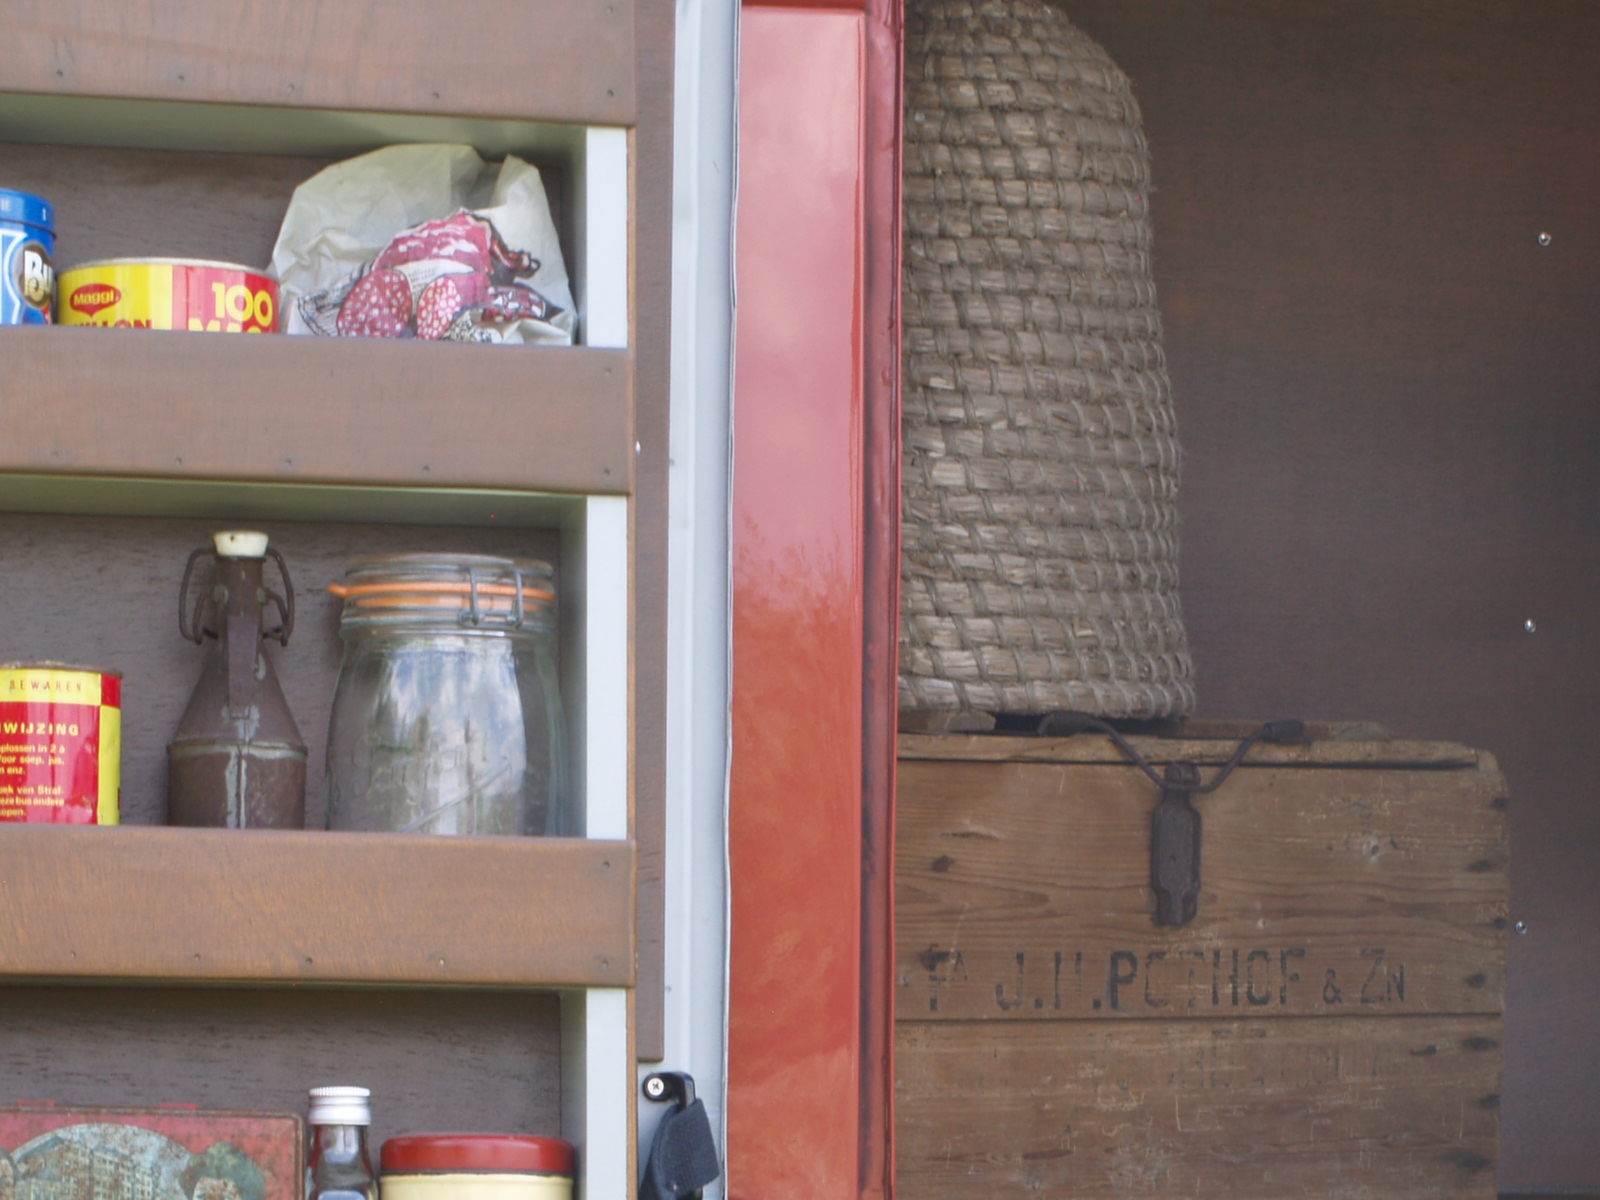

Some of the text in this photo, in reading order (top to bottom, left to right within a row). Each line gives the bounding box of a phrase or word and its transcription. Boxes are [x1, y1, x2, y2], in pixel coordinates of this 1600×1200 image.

[74, 288, 115, 305] Maggi
[212, 282, 273, 327] 100
[0, 721, 79, 736] WIJZING
[1323, 968, 1342, 1004] &
